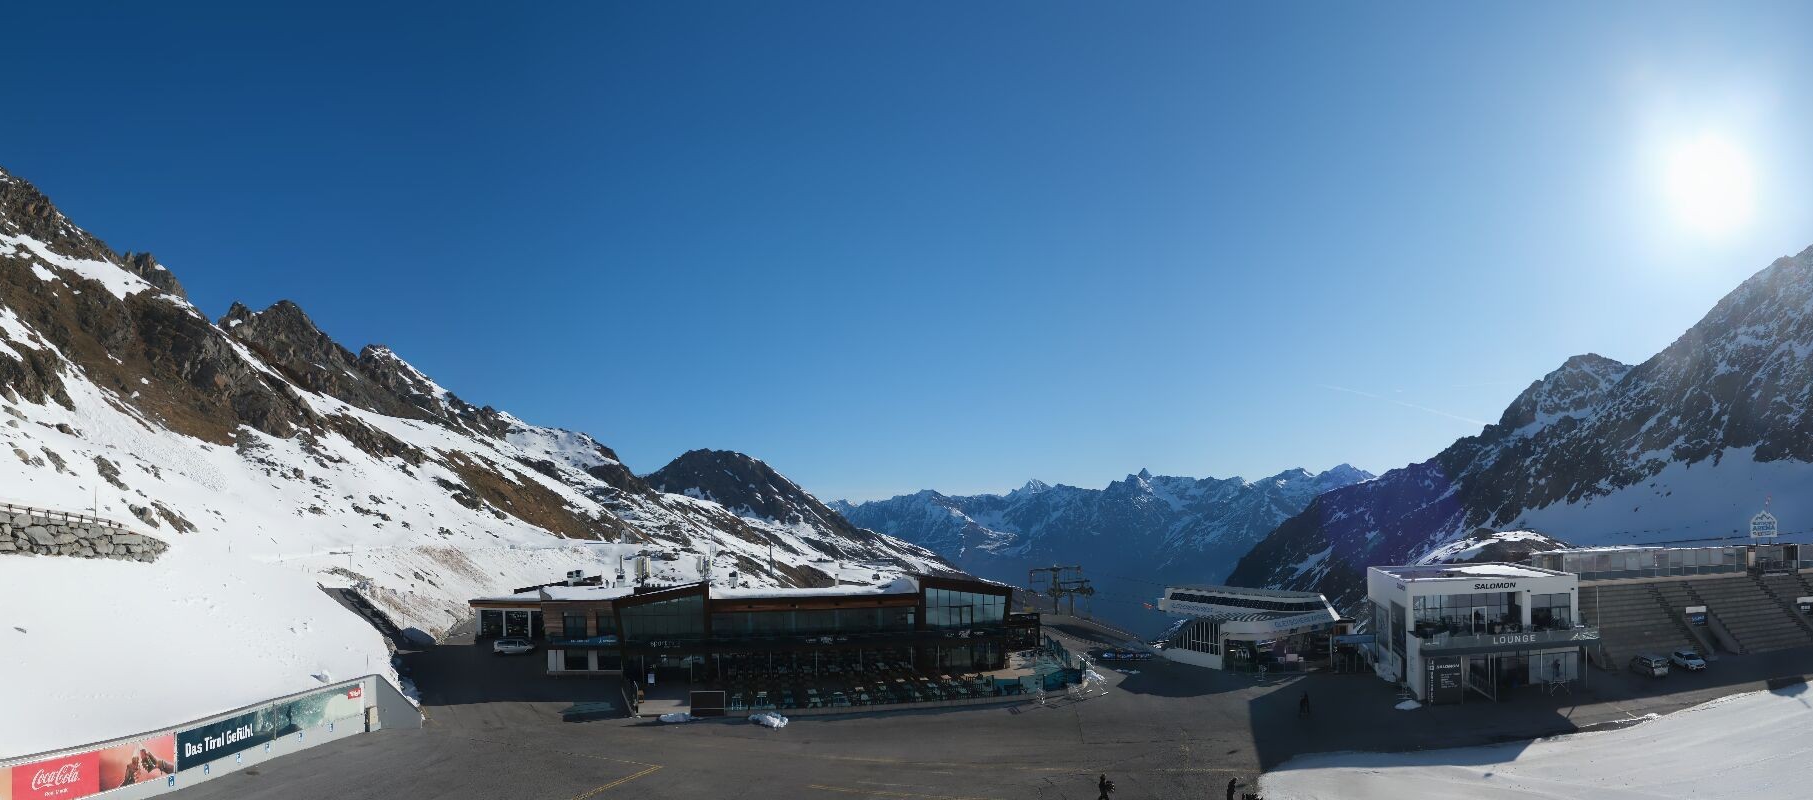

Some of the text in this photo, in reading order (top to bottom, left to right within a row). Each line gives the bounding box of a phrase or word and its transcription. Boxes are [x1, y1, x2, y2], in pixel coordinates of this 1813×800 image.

[1474, 582, 1516, 590] SALOMON
[1493, 634, 1536, 645] LOUNGE
[185, 723, 254, 758] Das Tirol Gefühl
